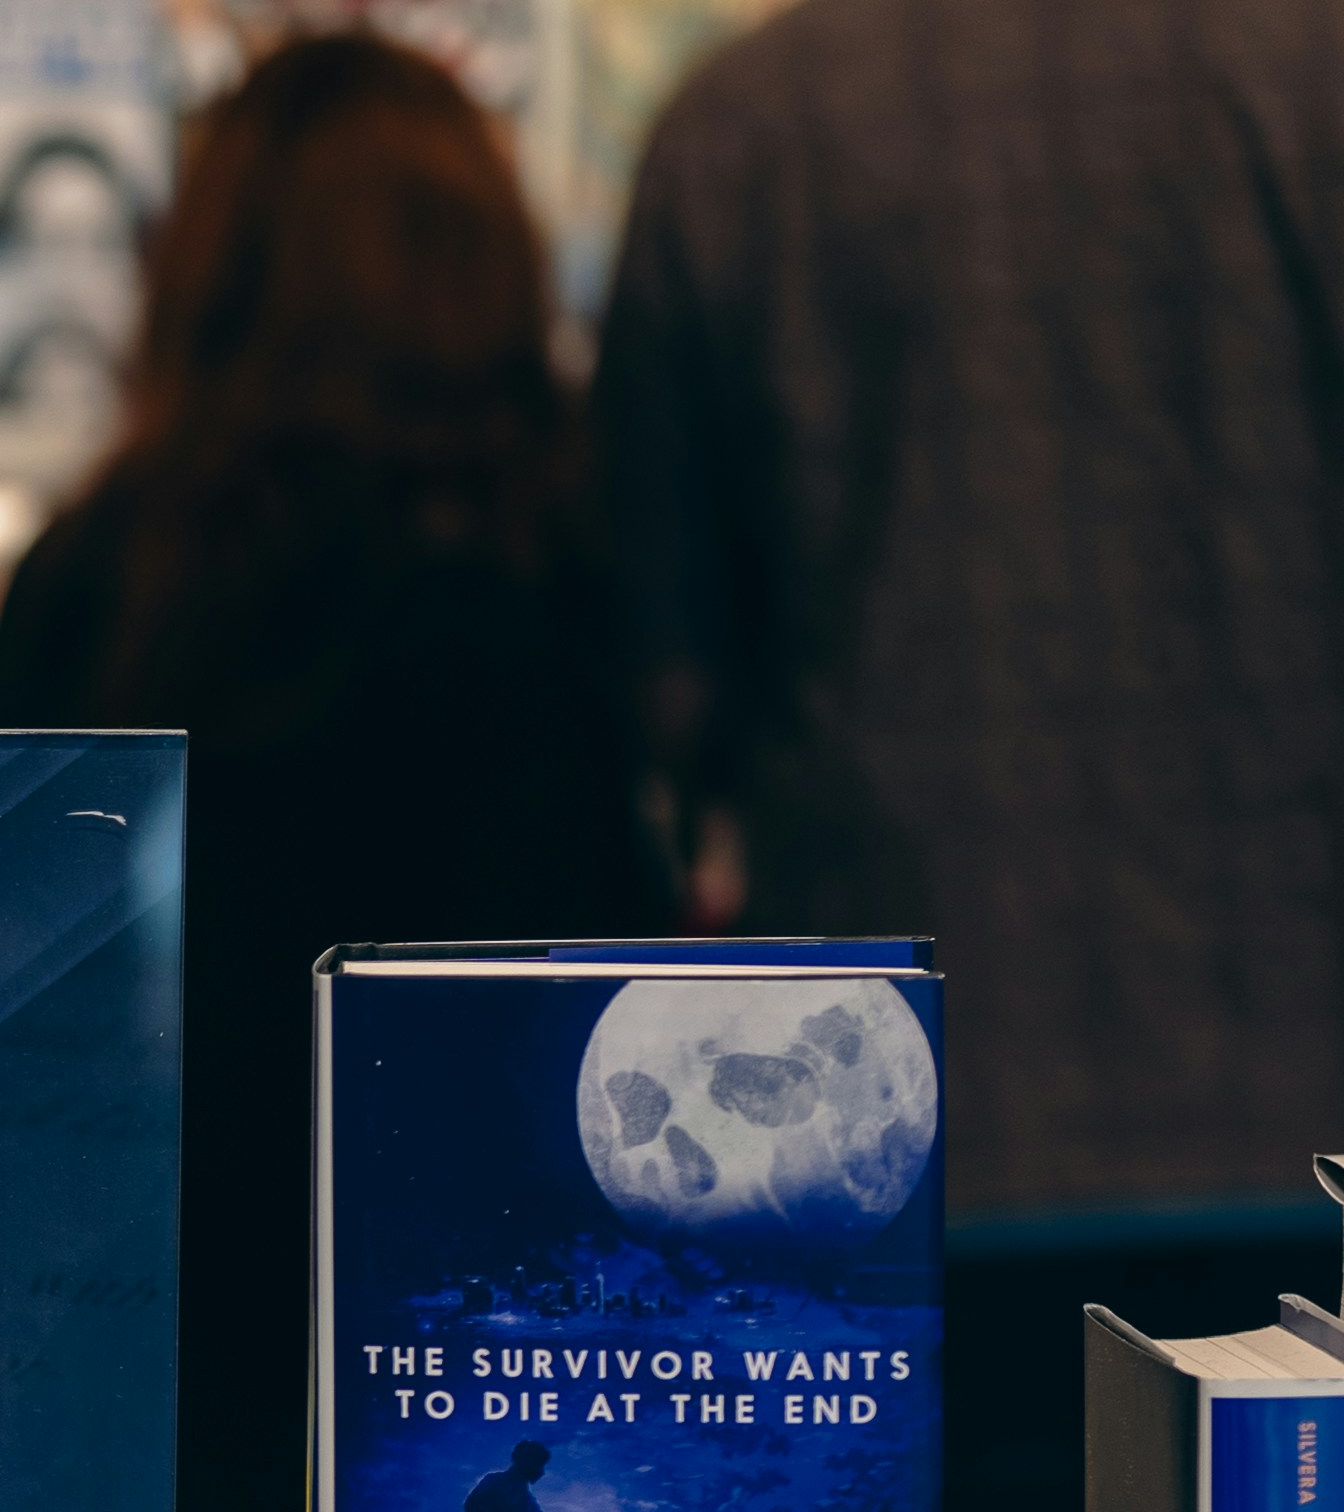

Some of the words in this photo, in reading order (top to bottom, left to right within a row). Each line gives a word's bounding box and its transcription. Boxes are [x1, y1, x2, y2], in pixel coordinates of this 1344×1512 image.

[363, 1345, 444, 1377] THE
[472, 1348, 714, 1380] SURVIVOR
[743, 1351, 911, 1381] WANTS
[395, 1389, 455, 1420] TO
[483, 1392, 559, 1422] DIE
[587, 1393, 641, 1424] AT
[671, 1394, 756, 1424] THE
[784, 1395, 878, 1425] END
[1297, 1421, 1316, 1505] SILVERA
